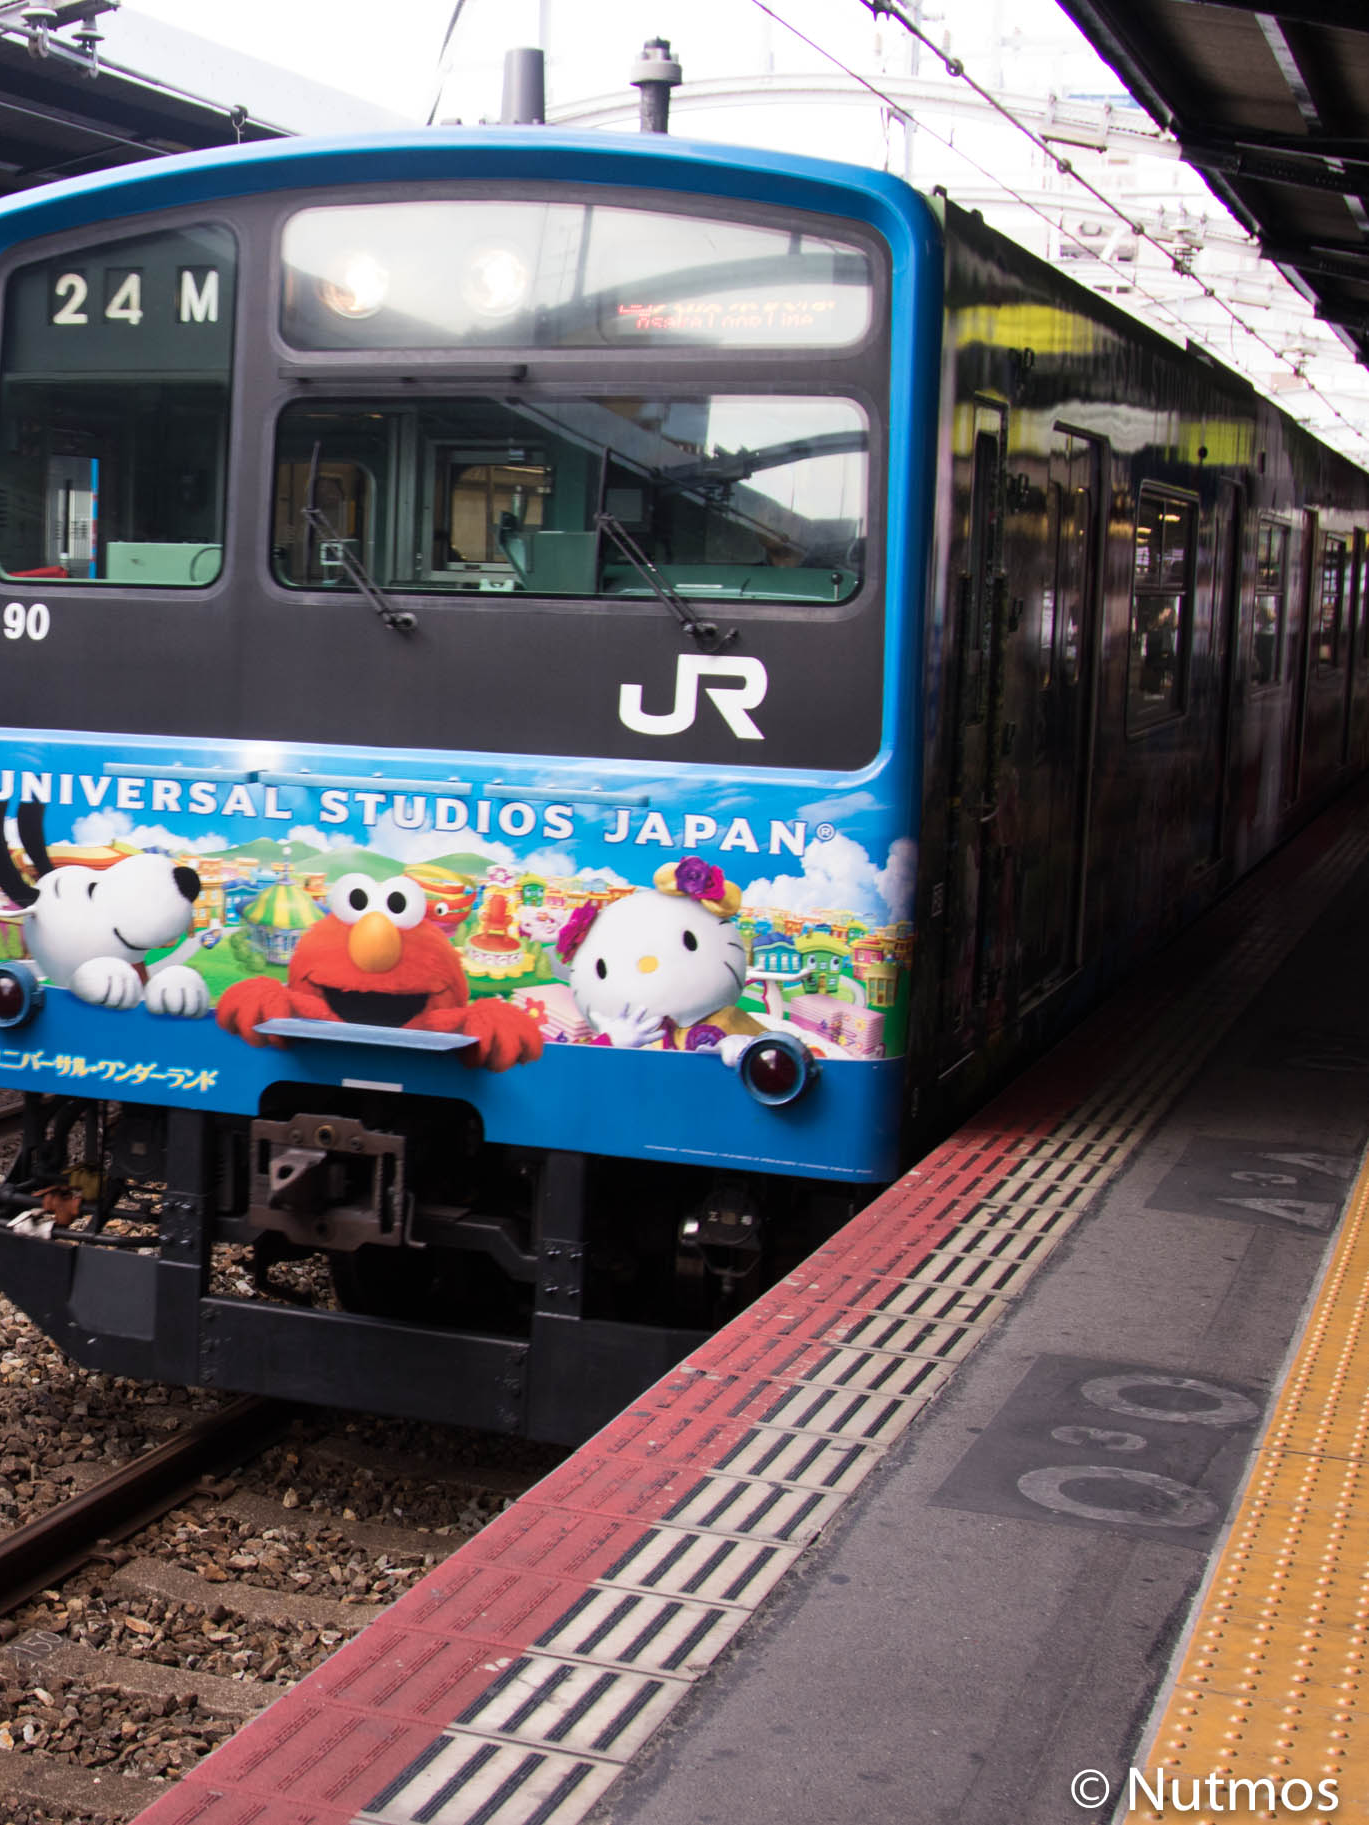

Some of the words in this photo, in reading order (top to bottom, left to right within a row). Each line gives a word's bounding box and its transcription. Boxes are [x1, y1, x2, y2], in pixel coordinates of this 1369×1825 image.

[180, 269, 219, 324] M
[2, 602, 51, 641] 90
[618, 652, 769, 741] JR
[318, 789, 575, 841] STUDIOS
